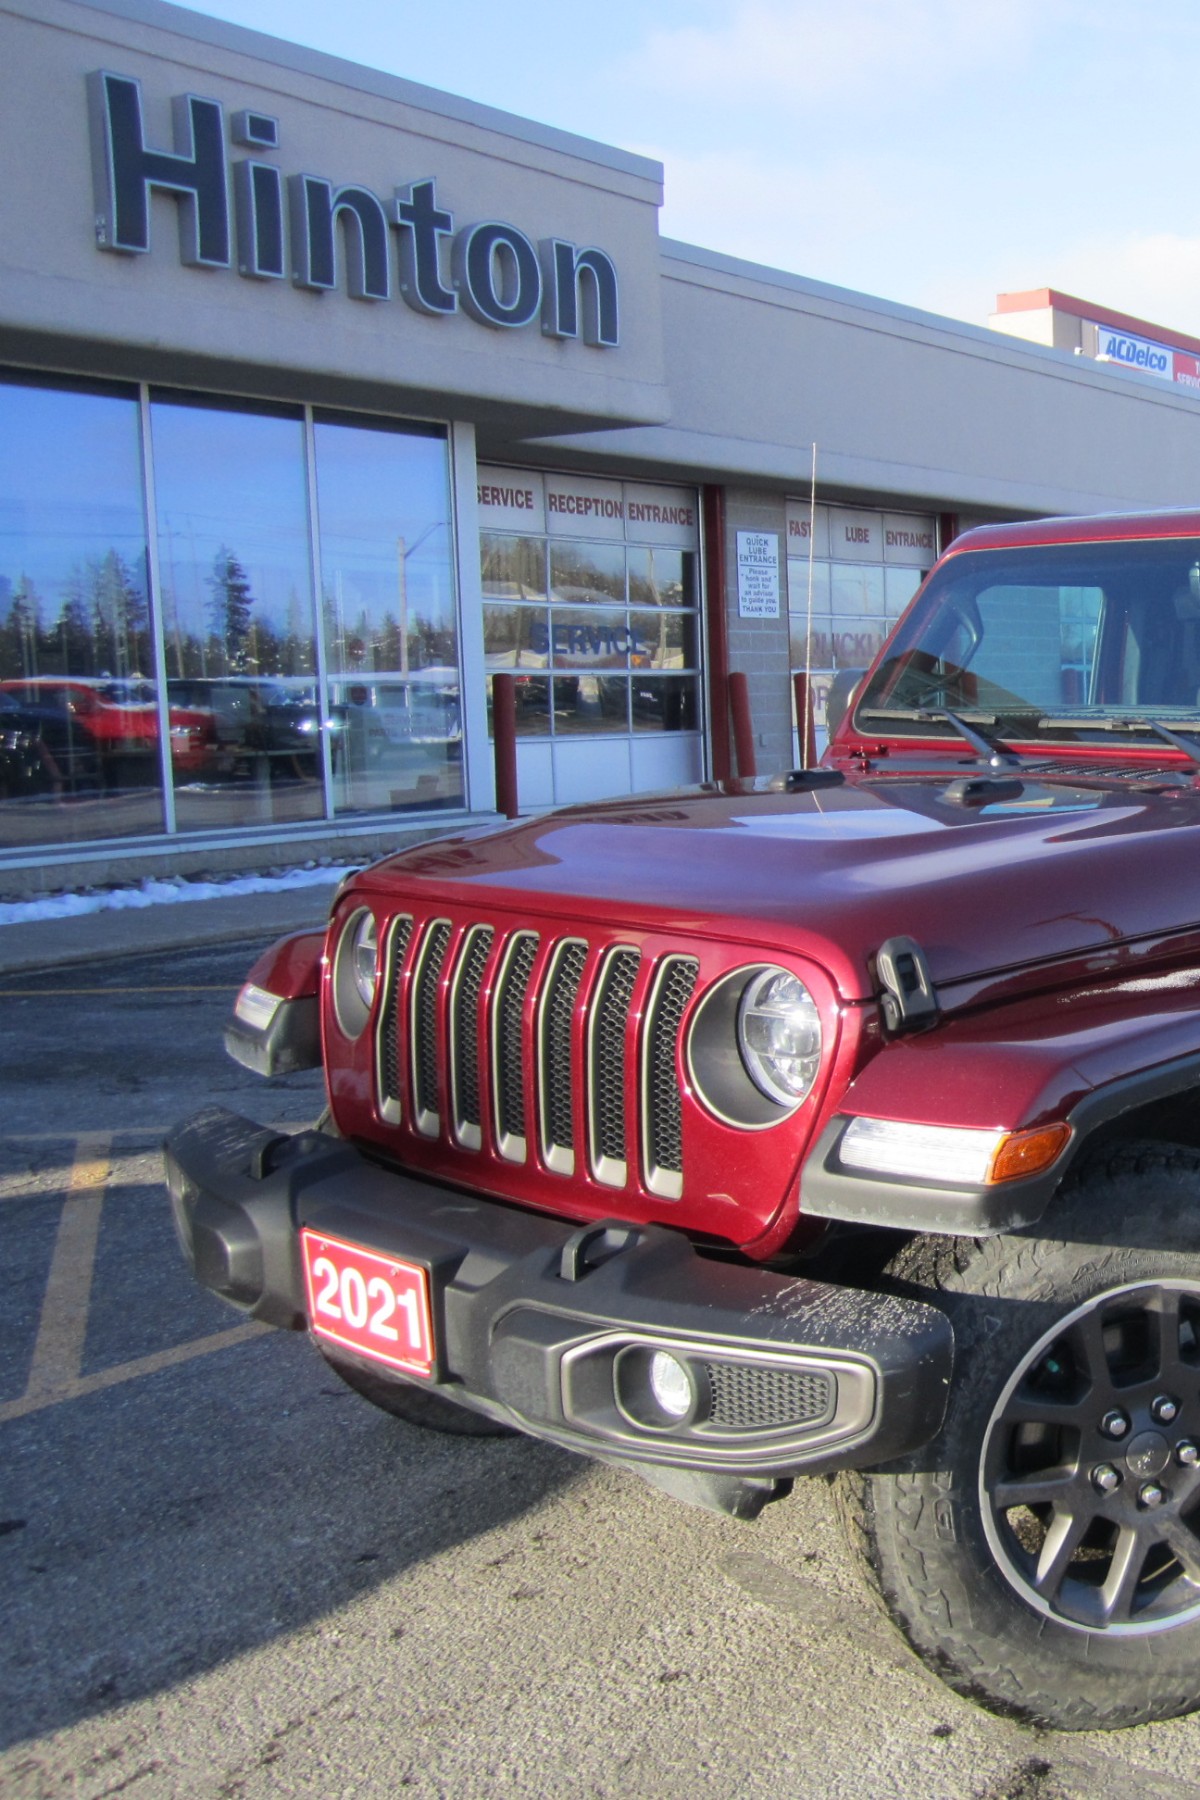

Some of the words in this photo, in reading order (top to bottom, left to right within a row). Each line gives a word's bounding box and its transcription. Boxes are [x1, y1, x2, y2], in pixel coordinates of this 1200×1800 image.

[87, 68, 621, 348] Hinton
[1106, 336, 1167, 371] ACDelco
[549, 493, 625, 519] RECEPTION
[629, 502, 694, 526] ENTRANCE
[746, 538, 769, 546] QUICK
[789, 519, 812, 538] FAST
[845, 526, 870, 543] LUBE
[885, 530, 933, 549] ENTRANCE
[740, 554, 777, 564] ENTRANCE
[748, 547, 768, 555] LUBE
[748, 568, 768, 576] Please
[742, 605, 763, 613] THANK
[764, 606, 777, 614] YOU
[529, 623, 648, 655] SERVICE
[313, 1257, 422, 1349] 2021
